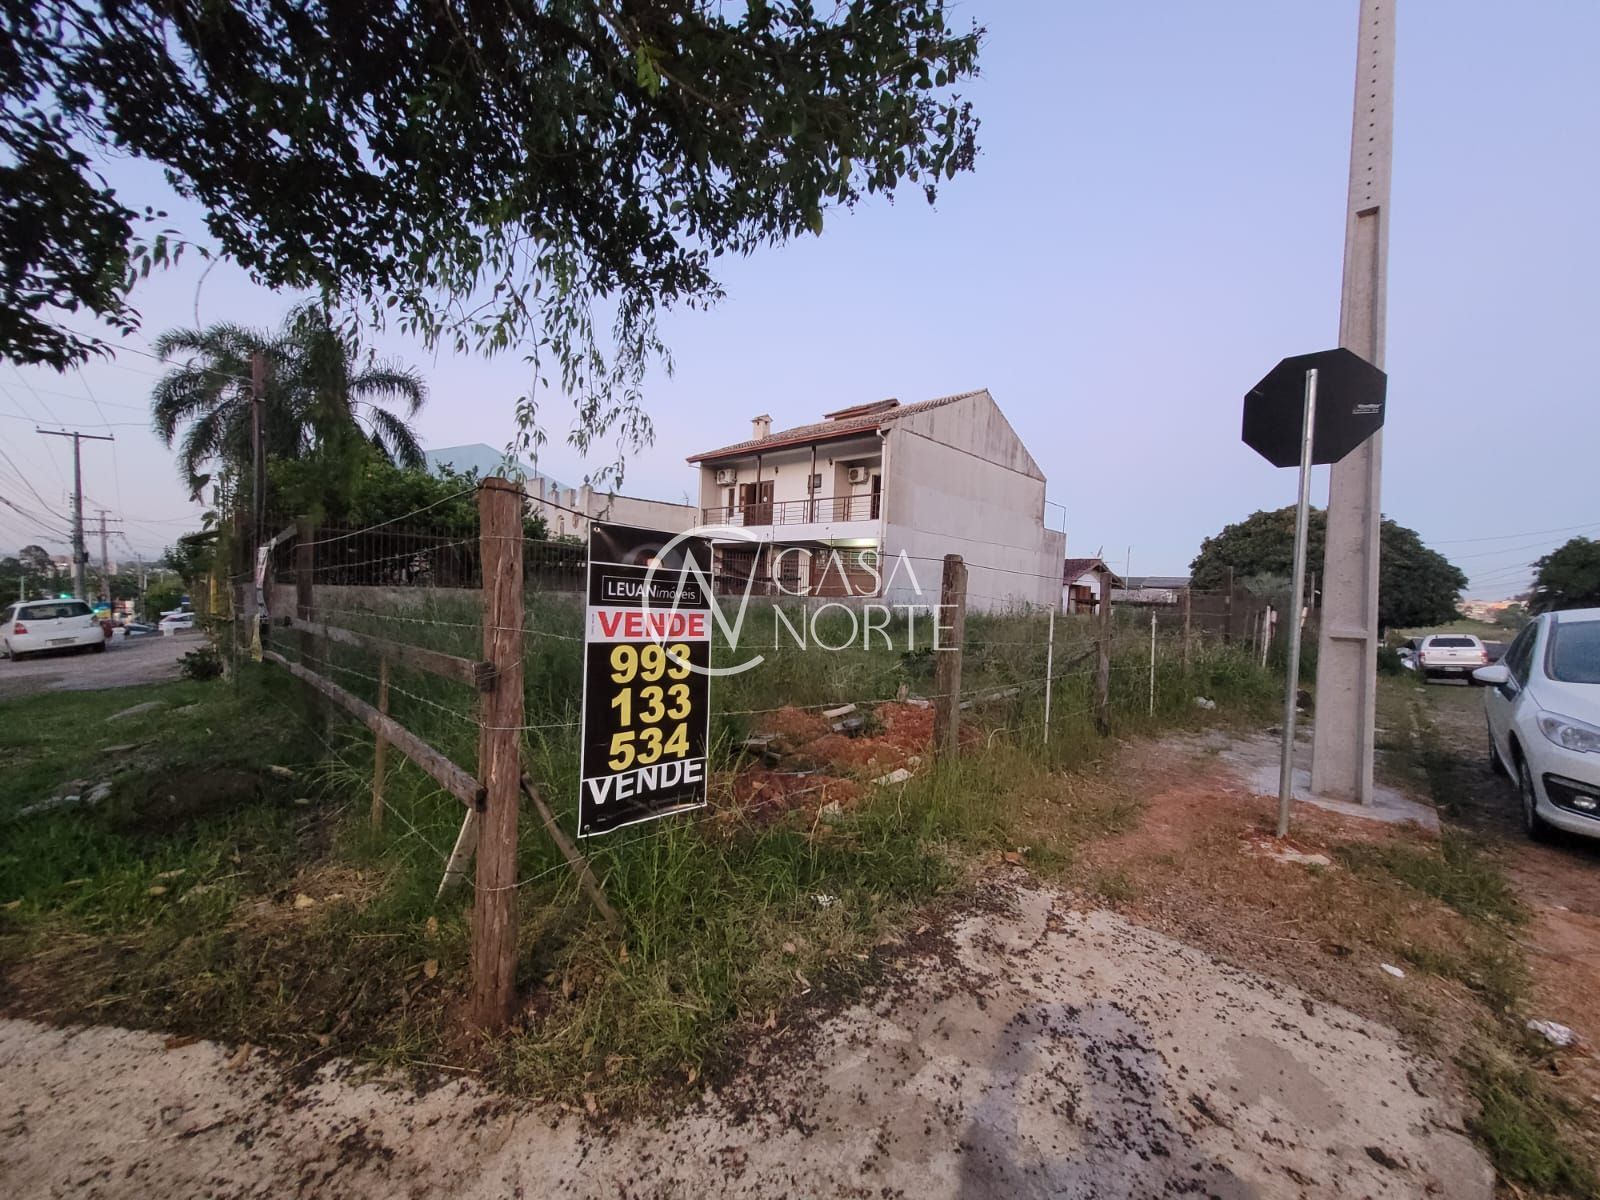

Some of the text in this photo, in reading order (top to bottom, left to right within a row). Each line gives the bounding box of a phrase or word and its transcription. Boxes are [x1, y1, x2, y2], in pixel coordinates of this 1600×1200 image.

[597, 611, 705, 638] VENDE
[610, 643, 692, 684] 993
[611, 683, 692, 727] 133
[608, 722, 690, 772] 534
[587, 758, 704, 805] VENDE
